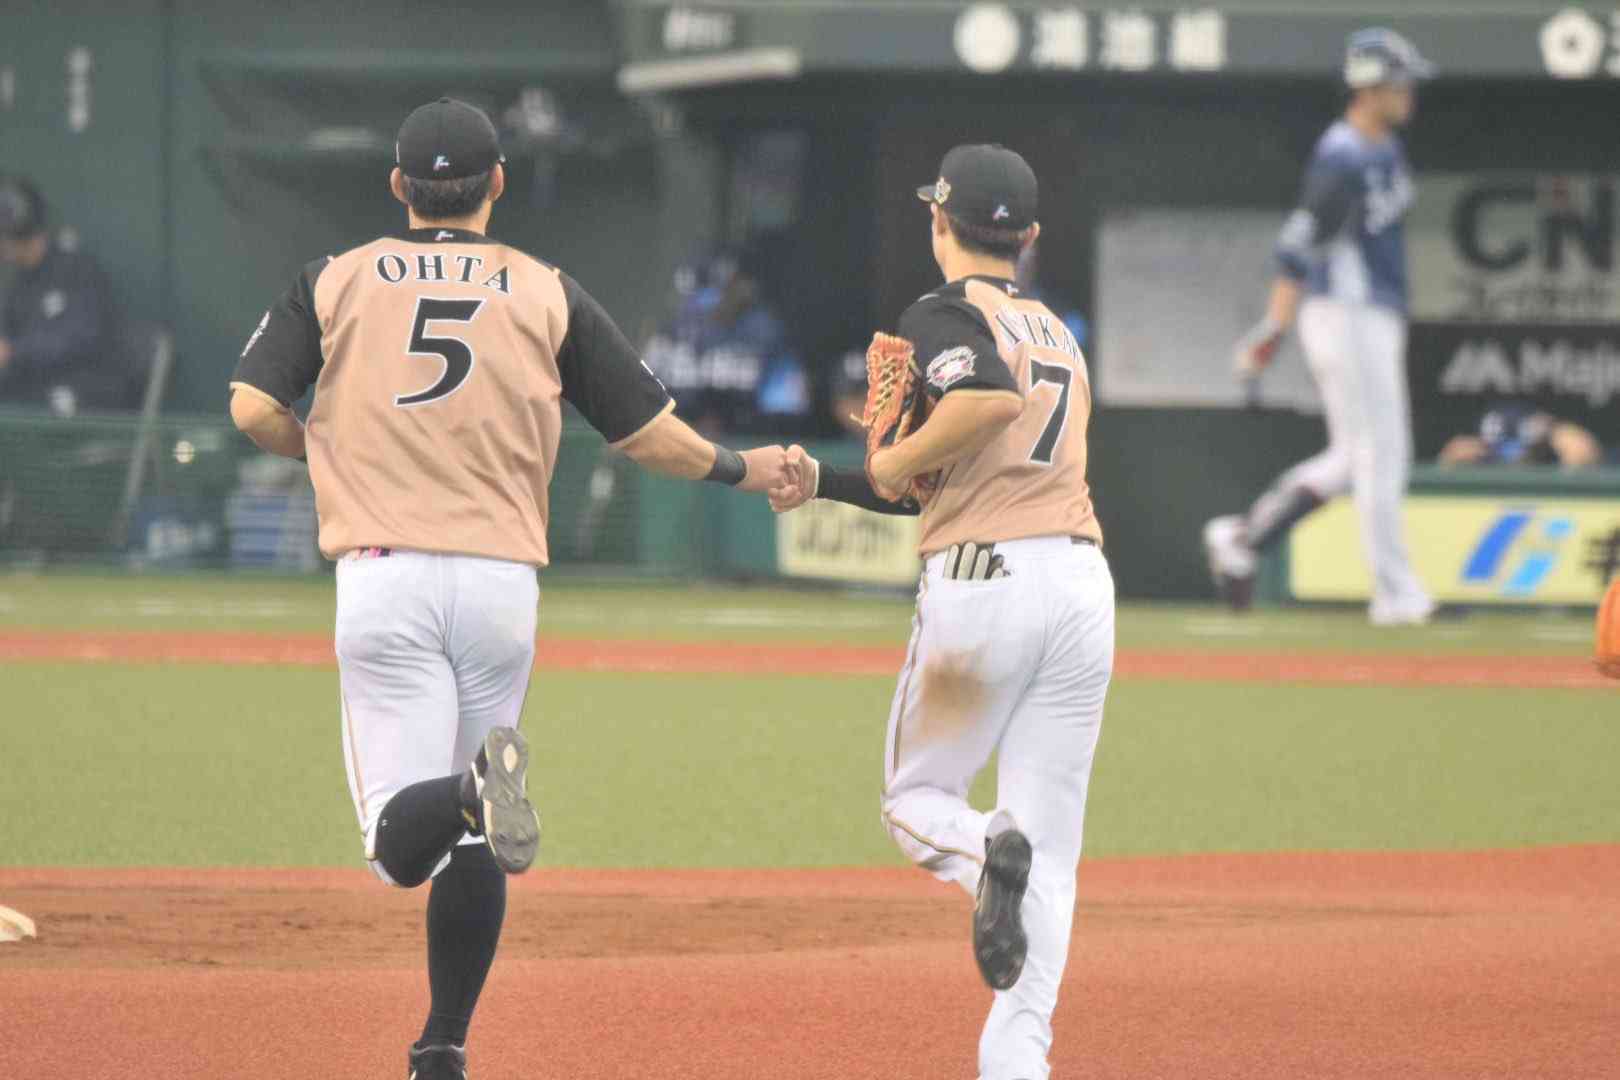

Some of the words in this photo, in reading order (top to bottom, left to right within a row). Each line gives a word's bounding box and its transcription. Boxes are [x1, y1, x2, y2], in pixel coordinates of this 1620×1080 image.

[375, 252, 512, 296] OHTA
[392, 296, 488, 407] 5
[1027, 355, 1074, 467] 7
